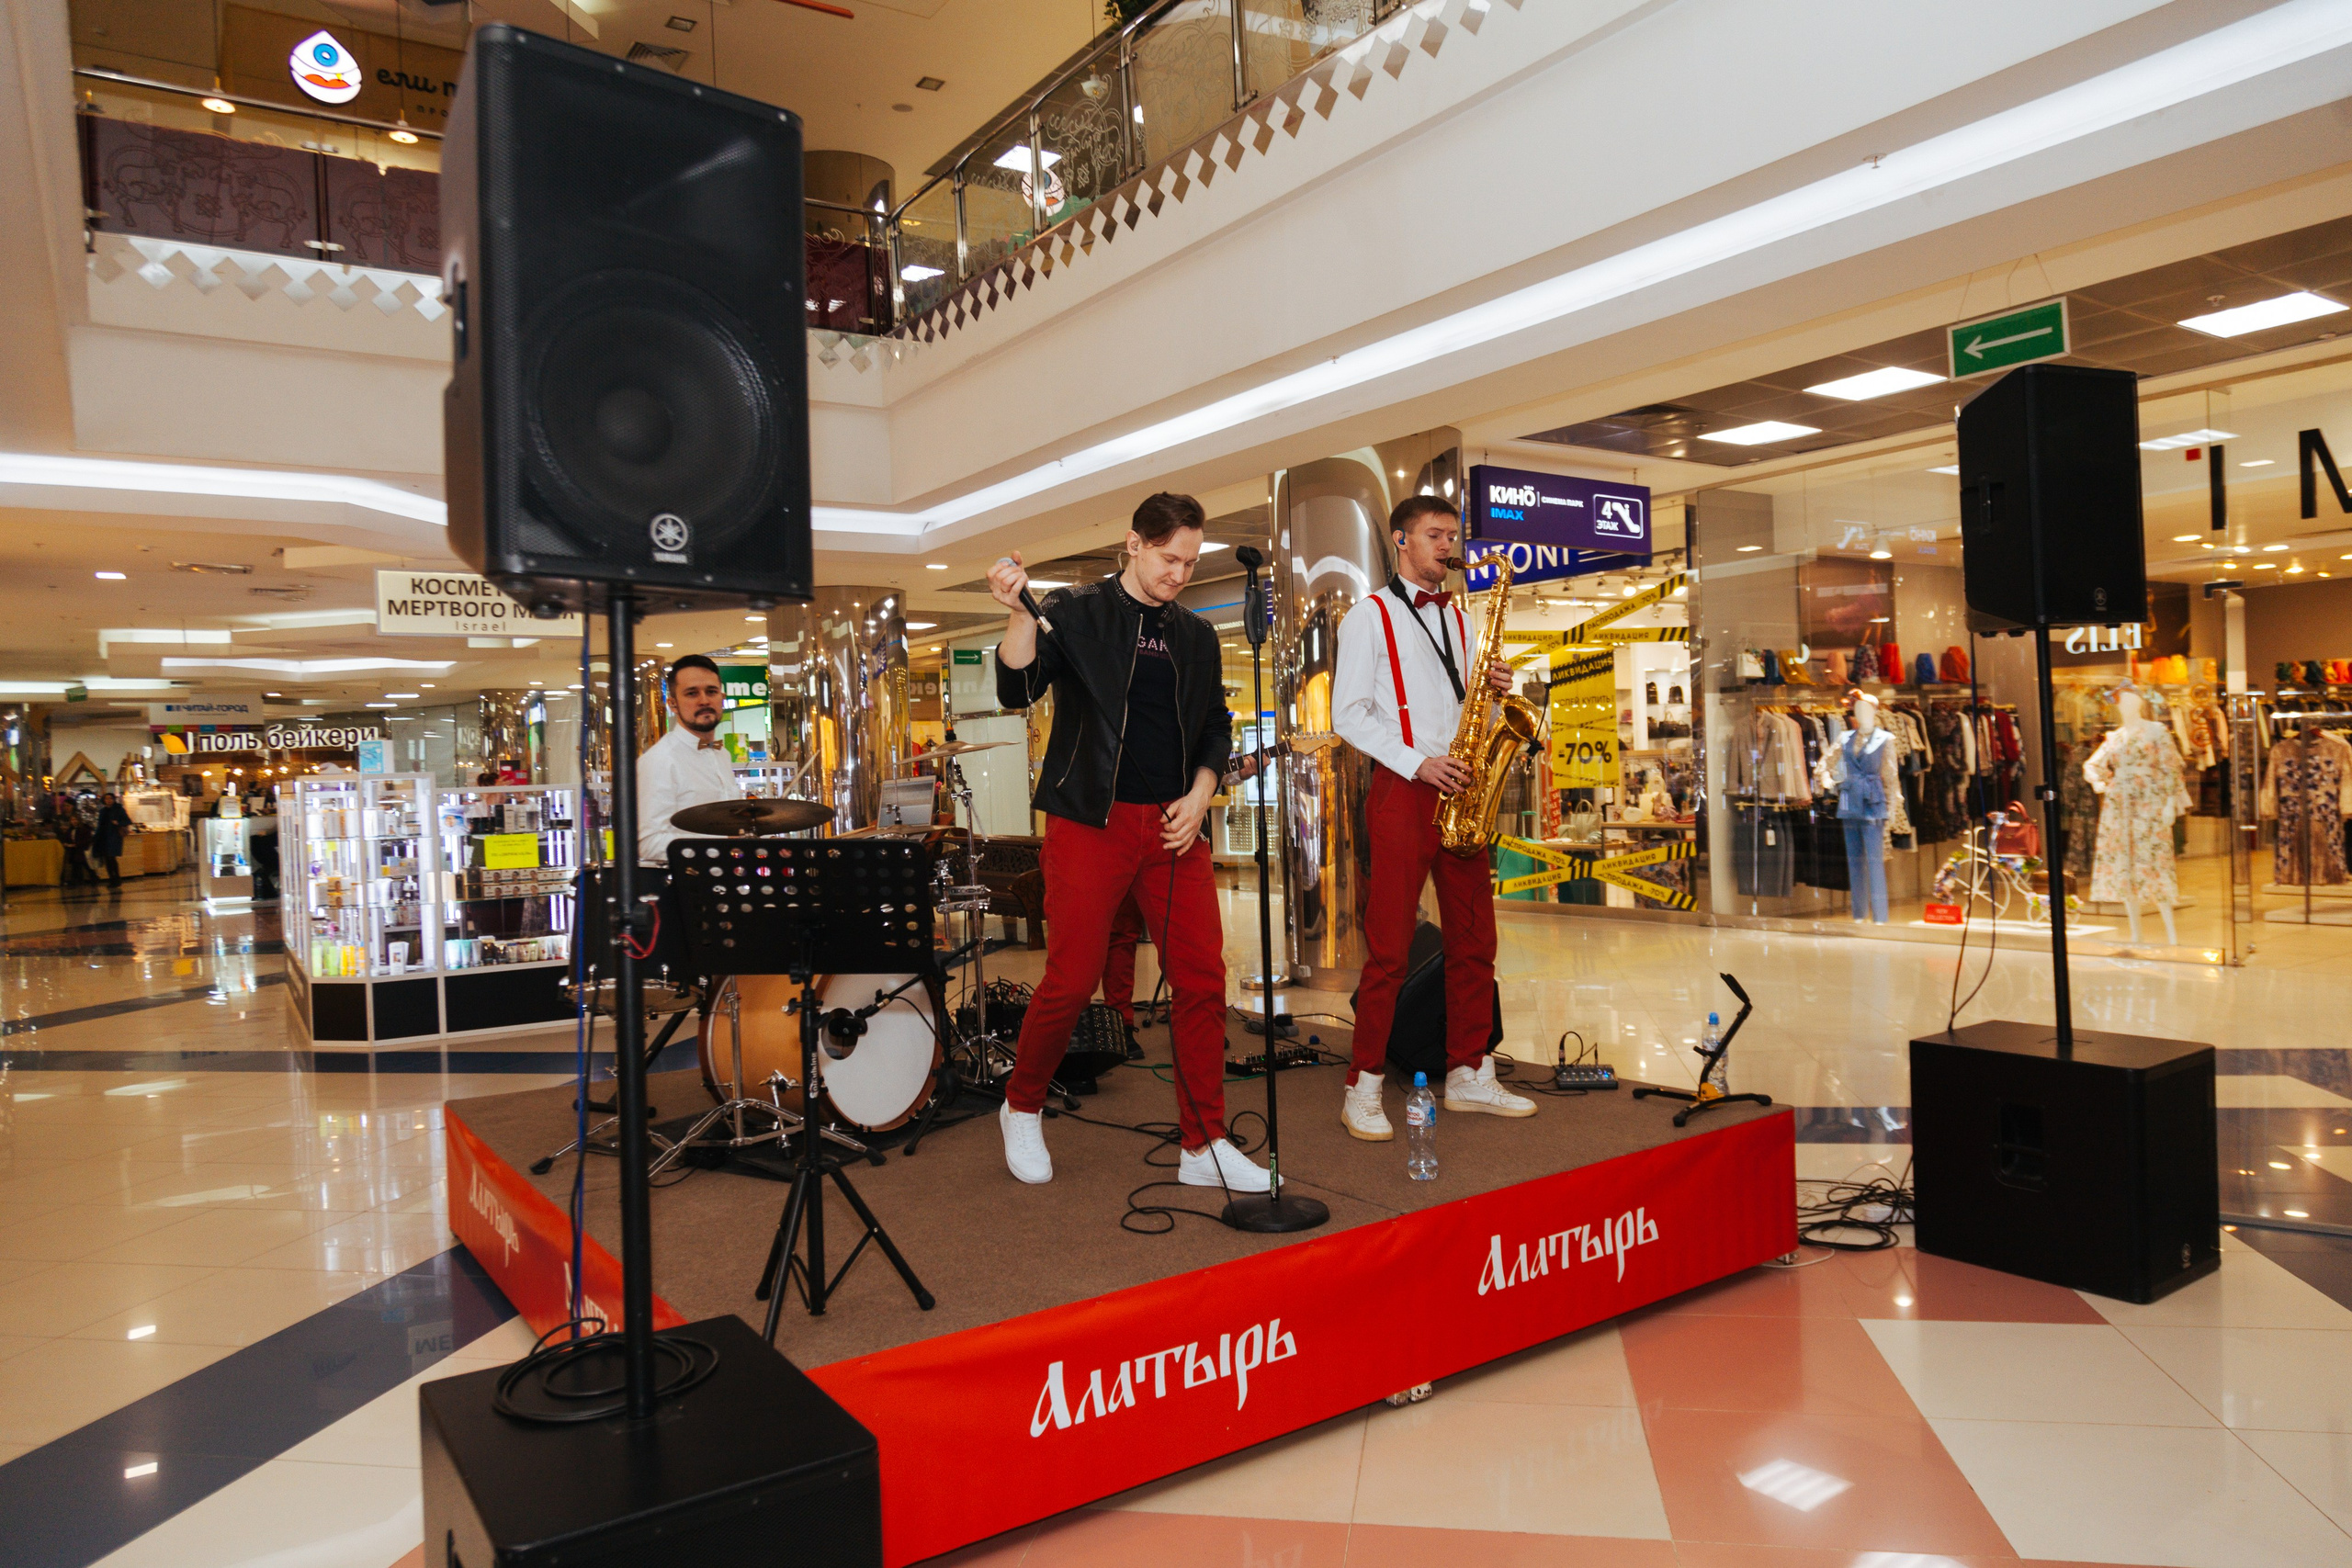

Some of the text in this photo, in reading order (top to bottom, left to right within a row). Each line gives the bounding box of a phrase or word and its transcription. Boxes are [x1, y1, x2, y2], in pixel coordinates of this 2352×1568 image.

[1490, 507, 1524, 521] IMAX
[1600, 501, 1613, 520] 4
[1597, 520, 1619, 532] ЭТАЖ
[1470, 542, 1569, 581] NTONI
[388, 600, 505, 619] МЕРТВОГО
[1587, 603, 1636, 631] РАСПРОДАЖА
[456, 621, 506, 632] Israel
[1594, 631, 1650, 641] ЛИКВИДАЦИЯ
[1552, 655, 1613, 682] ЛИКВИДАЦИЯ
[183, 703, 249, 714] ЧИТАЙ-ГОРОД
[198, 724, 379, 752] поль бейкери
[1558, 740, 1612, 765] -70%
[1502, 838, 1547, 860] РАСПРОДАЖА
[1601, 853, 1657, 871] ЛИКВИДАЦИЯ
[1513, 873, 1562, 888] ЛИКВИДАЦИЯ
[1476, 1206, 1659, 1296] Алатырь
[1030, 1318, 1297, 1438] Алатырь
